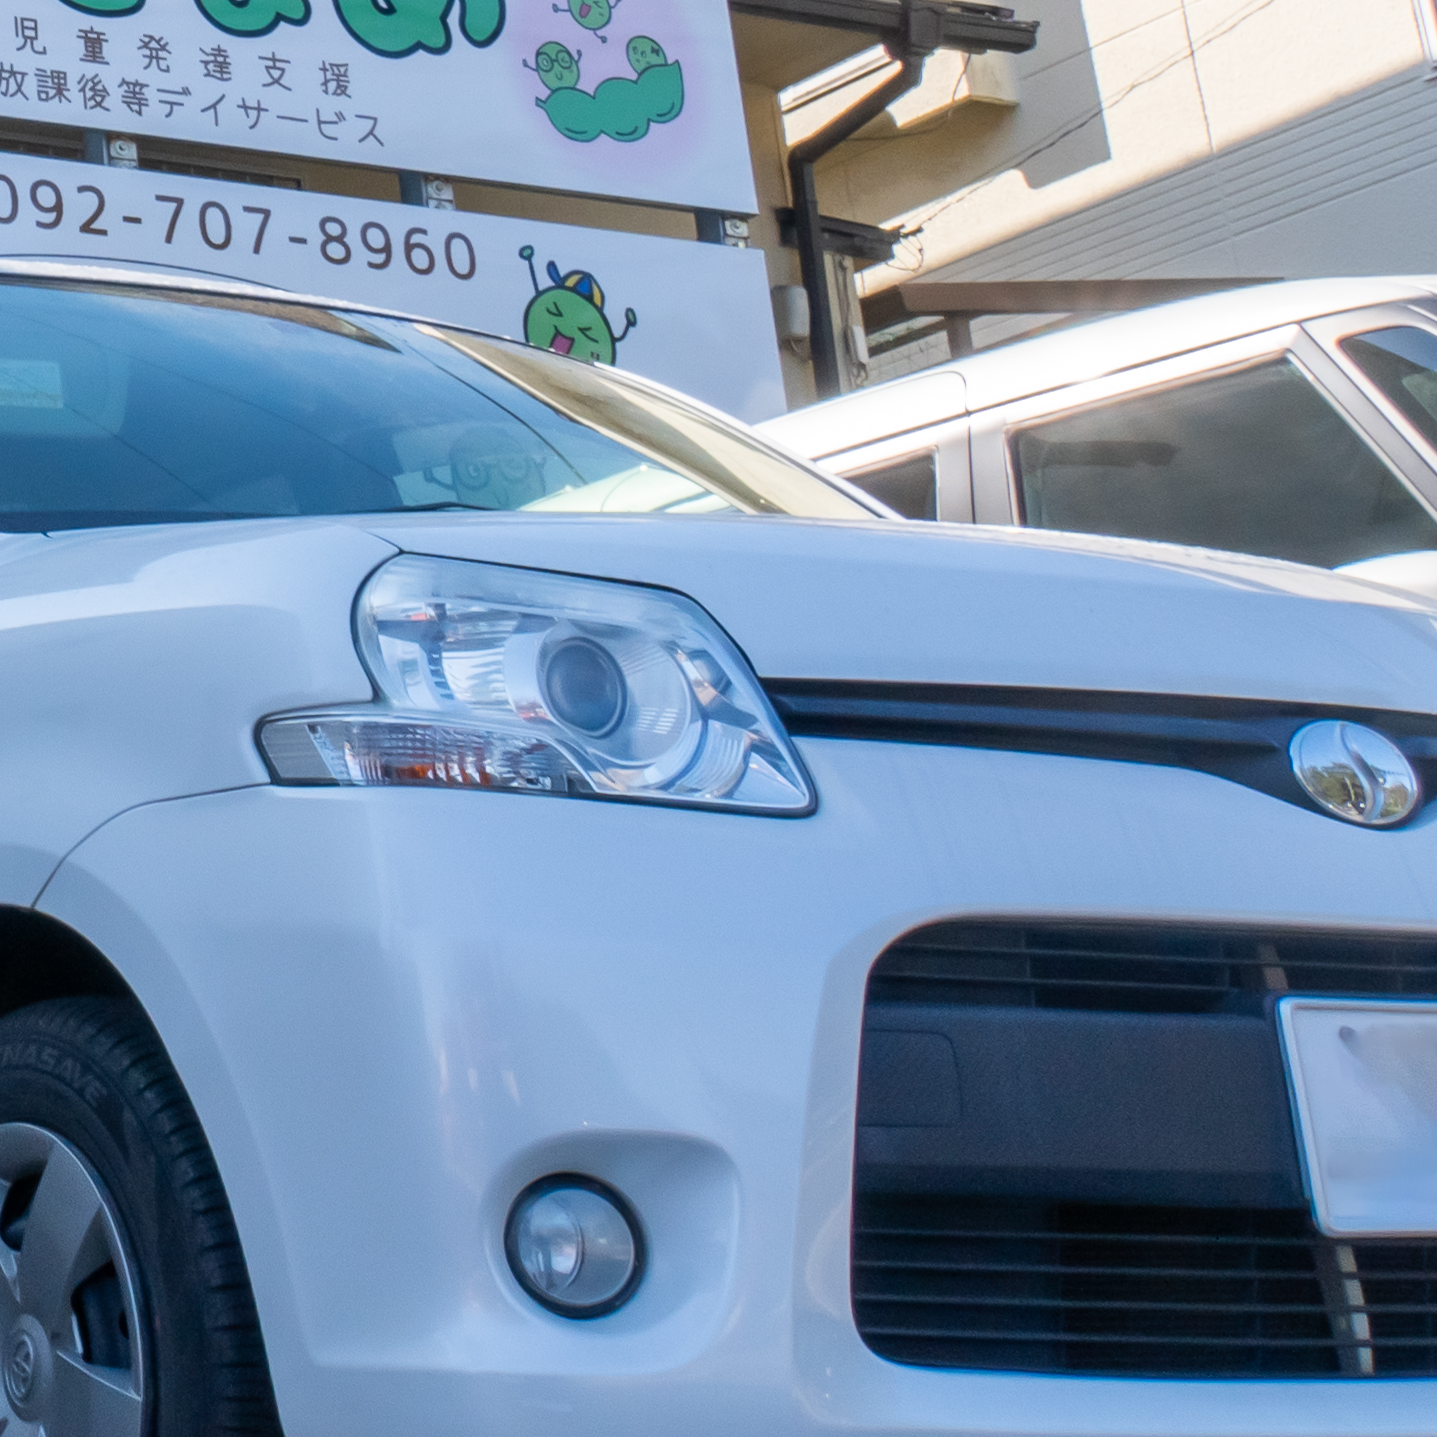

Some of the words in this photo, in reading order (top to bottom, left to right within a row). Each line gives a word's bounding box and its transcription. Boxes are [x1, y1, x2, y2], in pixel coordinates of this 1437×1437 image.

[12, 15, 353, 99] 児童発達支援
